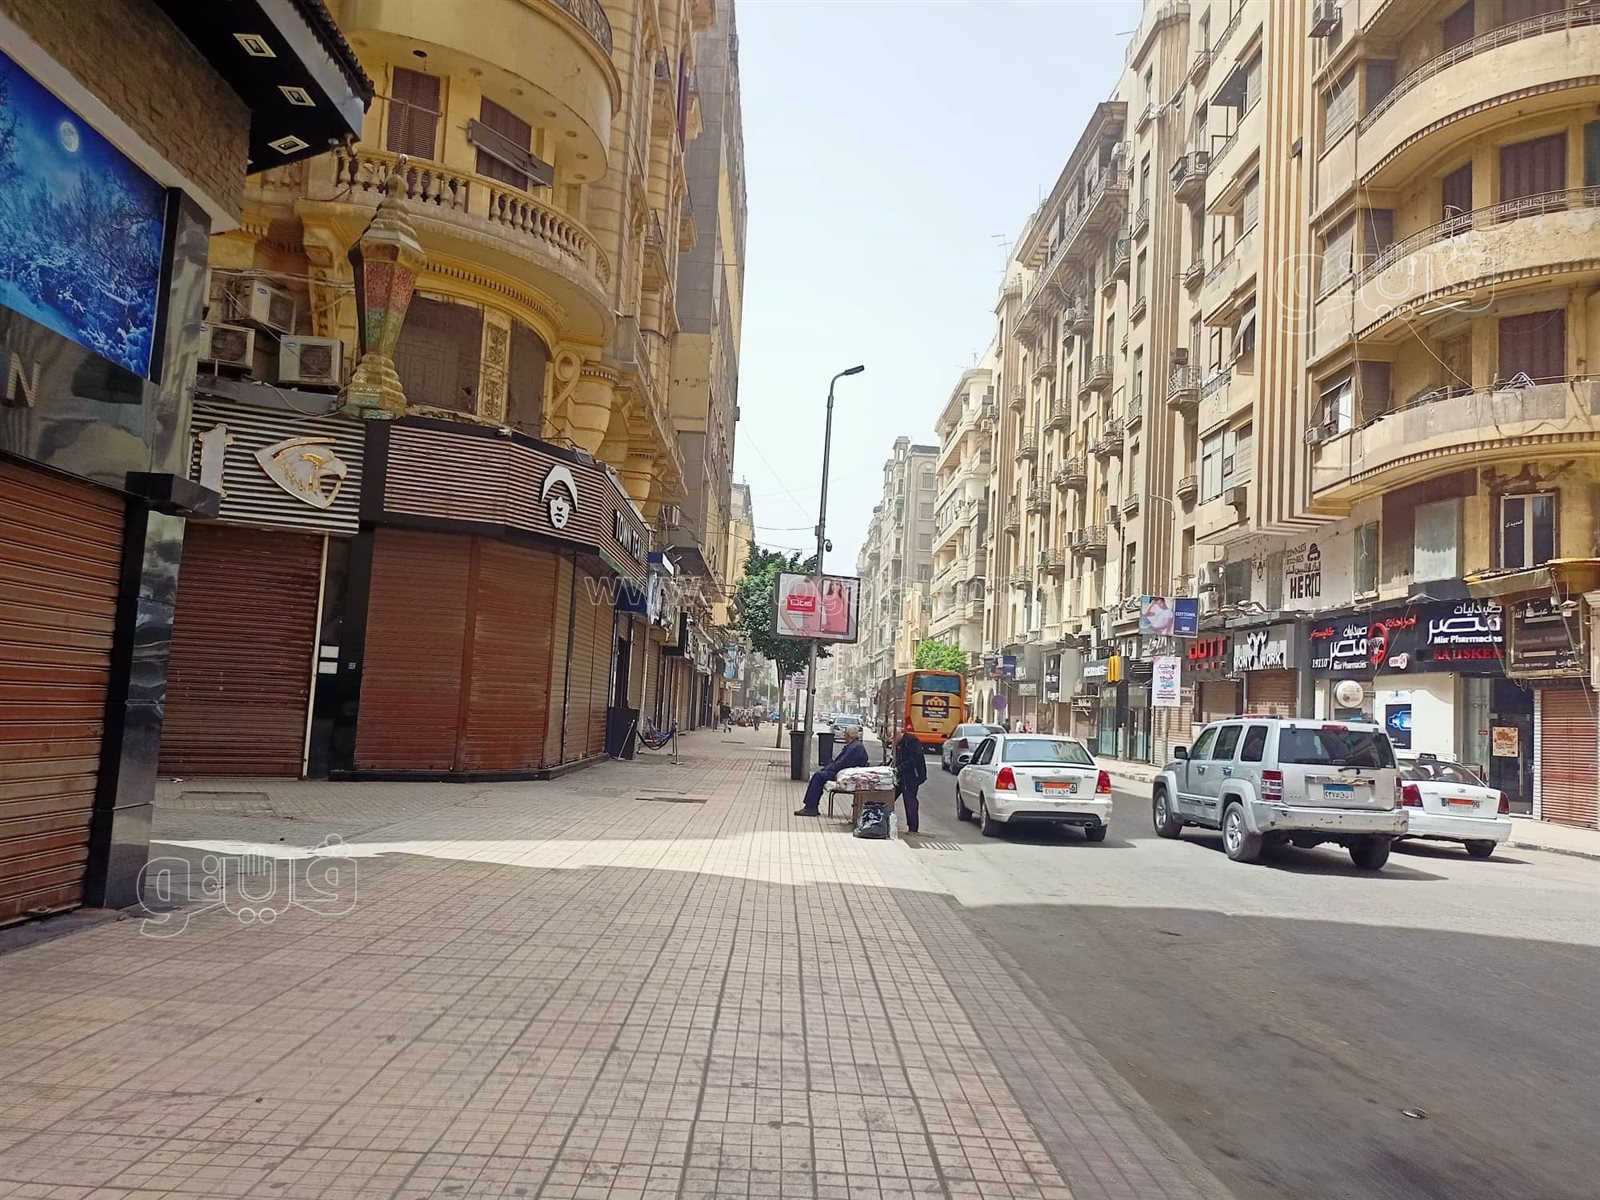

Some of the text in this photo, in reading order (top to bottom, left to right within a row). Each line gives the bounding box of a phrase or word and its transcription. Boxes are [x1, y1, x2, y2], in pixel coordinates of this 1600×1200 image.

[1453, 602, 1502, 617] صيدليات
[1427, 615, 1501, 645] مصر
[1433, 636, 1449, 644] Misr
[1328, 638, 1367, 670] مصر
